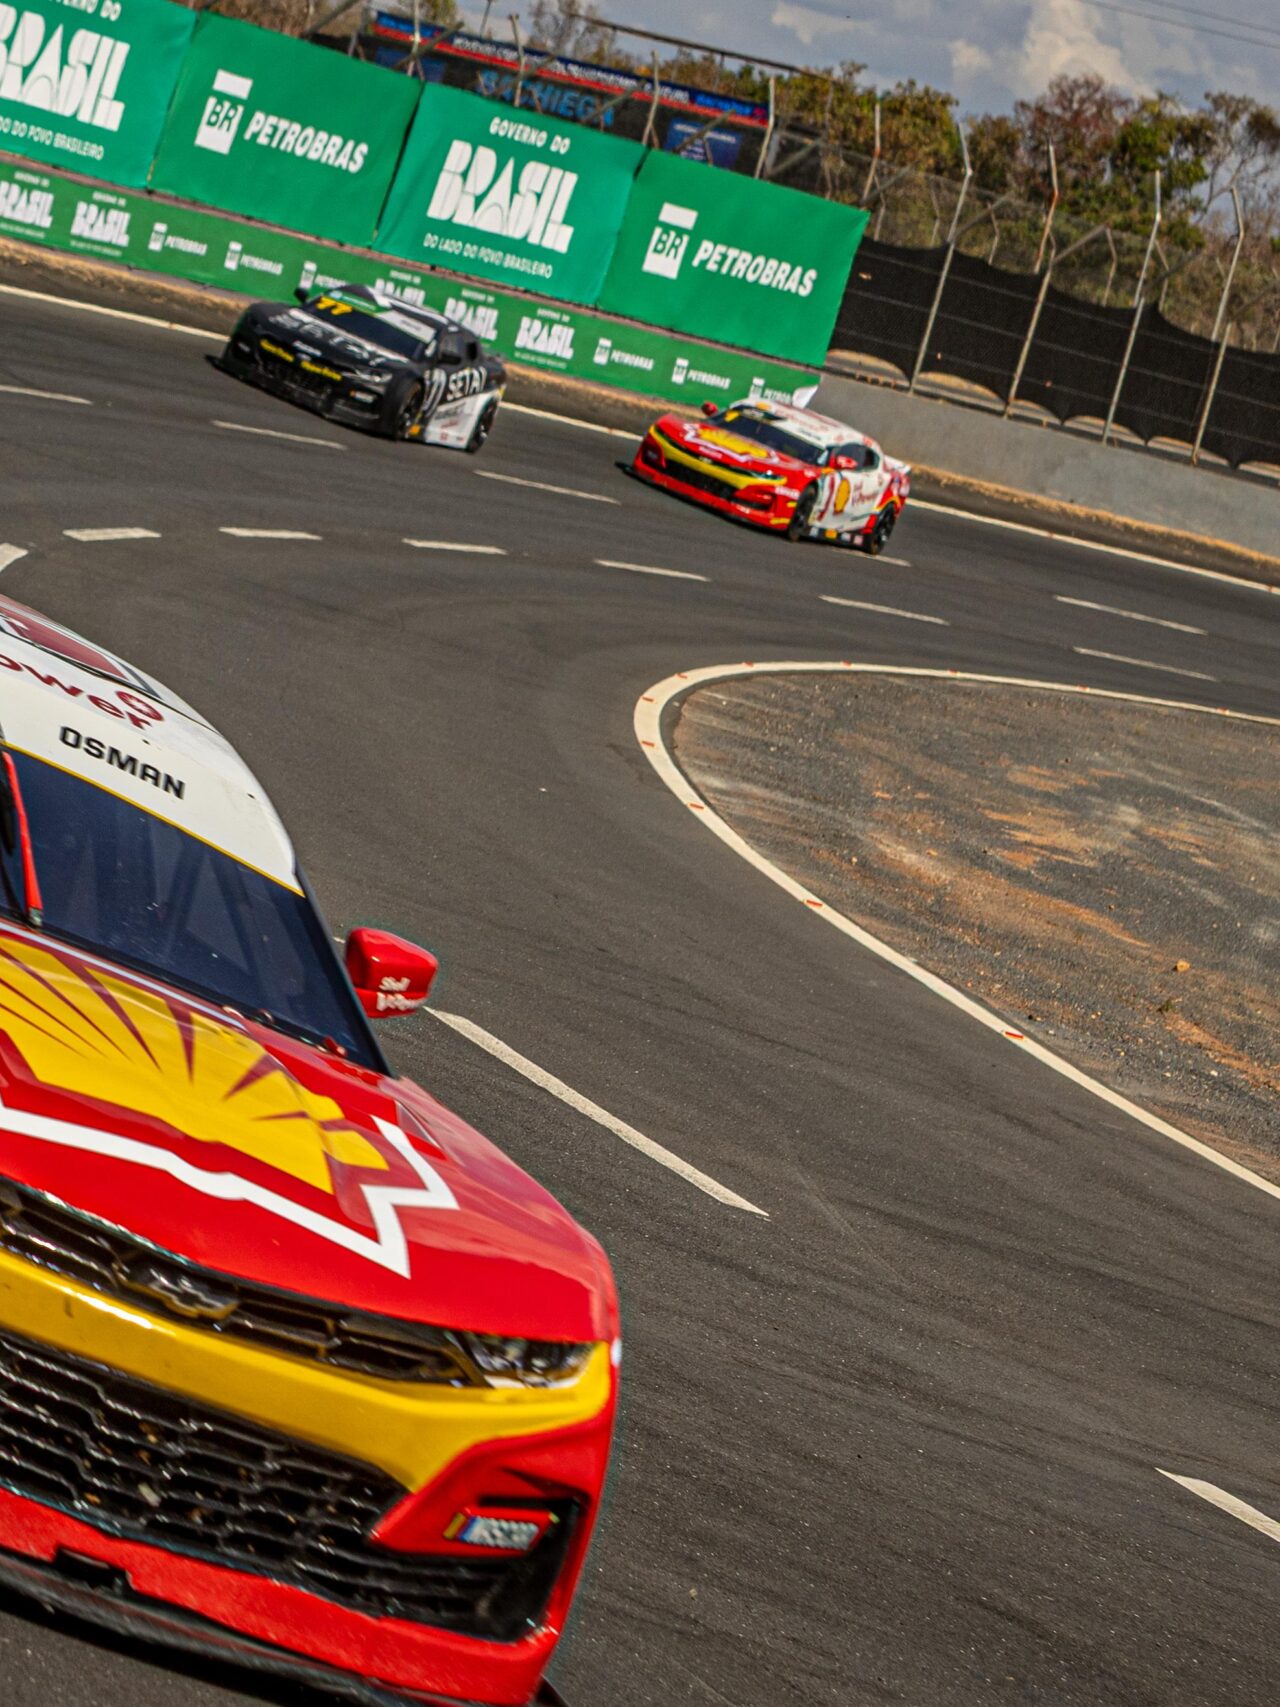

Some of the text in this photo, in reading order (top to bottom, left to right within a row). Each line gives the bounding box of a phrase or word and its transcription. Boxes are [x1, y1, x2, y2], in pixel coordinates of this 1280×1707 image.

[11, 120, 27, 137] DO
[28, 125, 53, 145] POVO
[53, 132, 105, 160] BRASILEIRO
[243, 111, 368, 174] PETROBRAS
[489, 116, 570, 154] GOVERNO DO
[426, 139, 578, 254] BRASIL
[70, 201, 131, 248] BRASIL
[423, 232, 553, 279] DO LADO DO POVO BRASILEIRO
[691, 239, 818, 297] PETROBRAS
[443, 297, 499, 341] BRASIL
[514, 316, 575, 360] BRASIL
[58, 725, 187, 801] OSMAN
